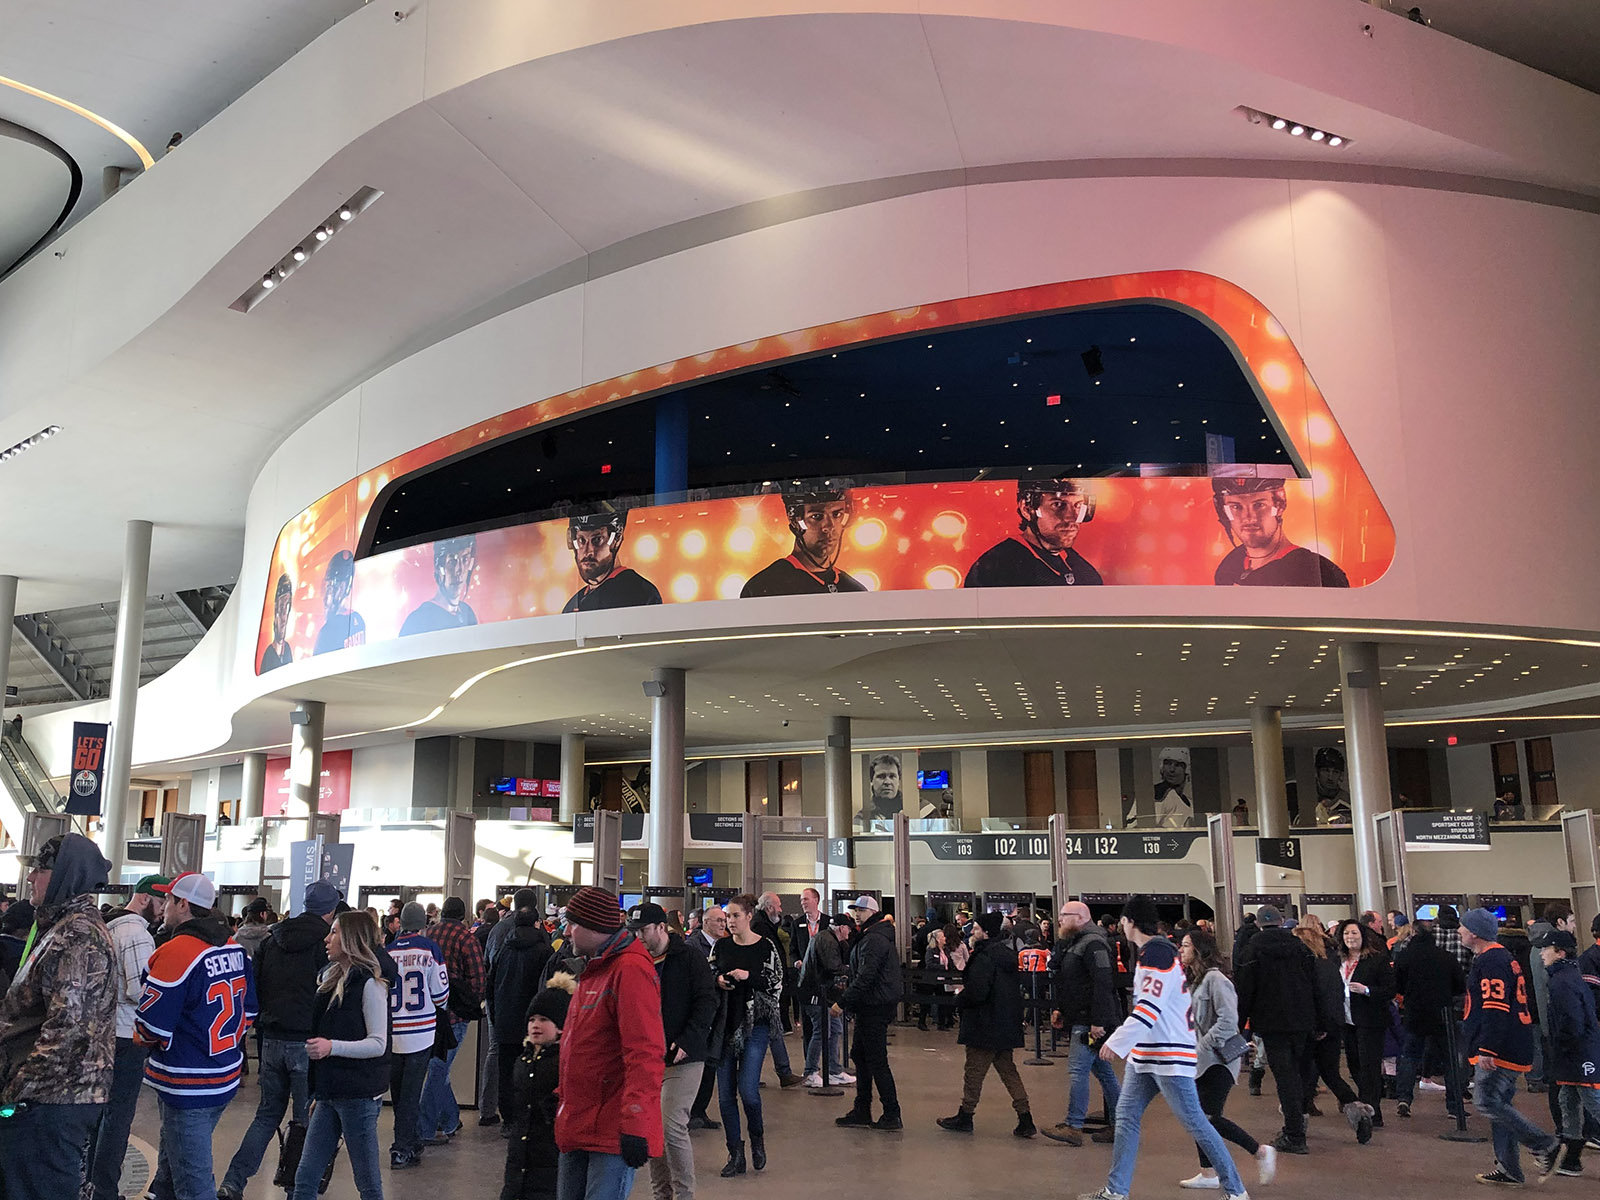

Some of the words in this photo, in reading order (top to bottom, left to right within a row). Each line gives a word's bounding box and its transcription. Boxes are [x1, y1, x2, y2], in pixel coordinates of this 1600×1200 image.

[77, 736, 104, 749] LET'S
[74, 748, 101, 770] GO
[837, 840, 845, 856] 3
[957, 844, 972, 855] 103
[994, 837, 1017, 855] 102
[1028, 837, 1048, 855] 101
[1065, 836, 1082, 855] 34
[1094, 836, 1118, 855] 132
[1144, 842, 1160, 854] 130
[1286, 841, 1295, 857] 3
[1022, 954, 1040, 972] 97
[1142, 975, 1164, 998] 29
[1480, 978, 1505, 1000] 93
[206, 974, 248, 1057] 27
